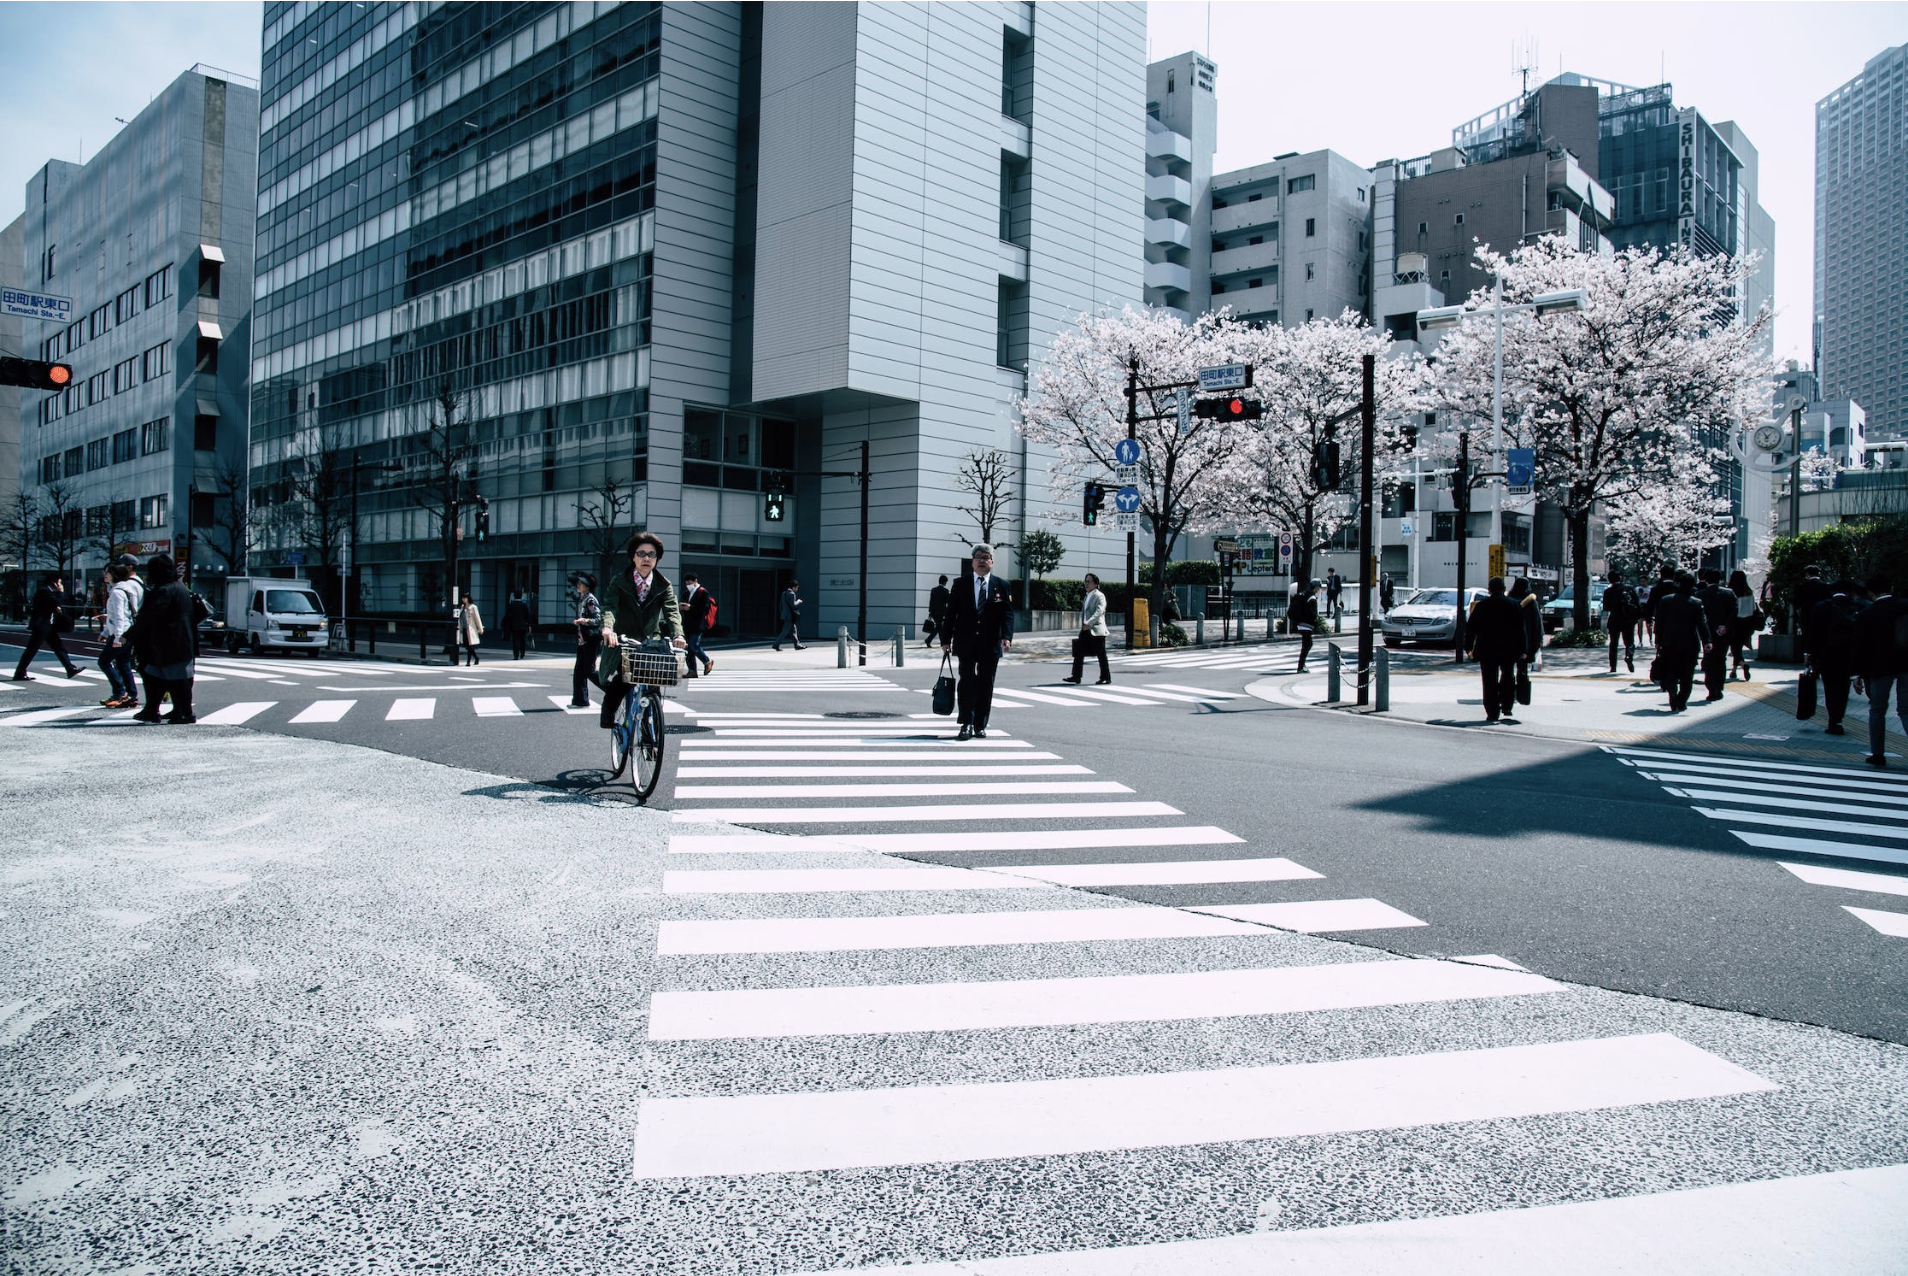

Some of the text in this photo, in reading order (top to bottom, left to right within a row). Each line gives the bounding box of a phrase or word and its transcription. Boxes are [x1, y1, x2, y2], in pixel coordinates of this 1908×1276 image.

[1680, 122, 1693, 213] SHIBAURA
[4, 291, 70, 311] 田町駅東口
[7, 304, 38, 315] Tamachi
[1201, 367, 1243, 380] 田町駅東口
